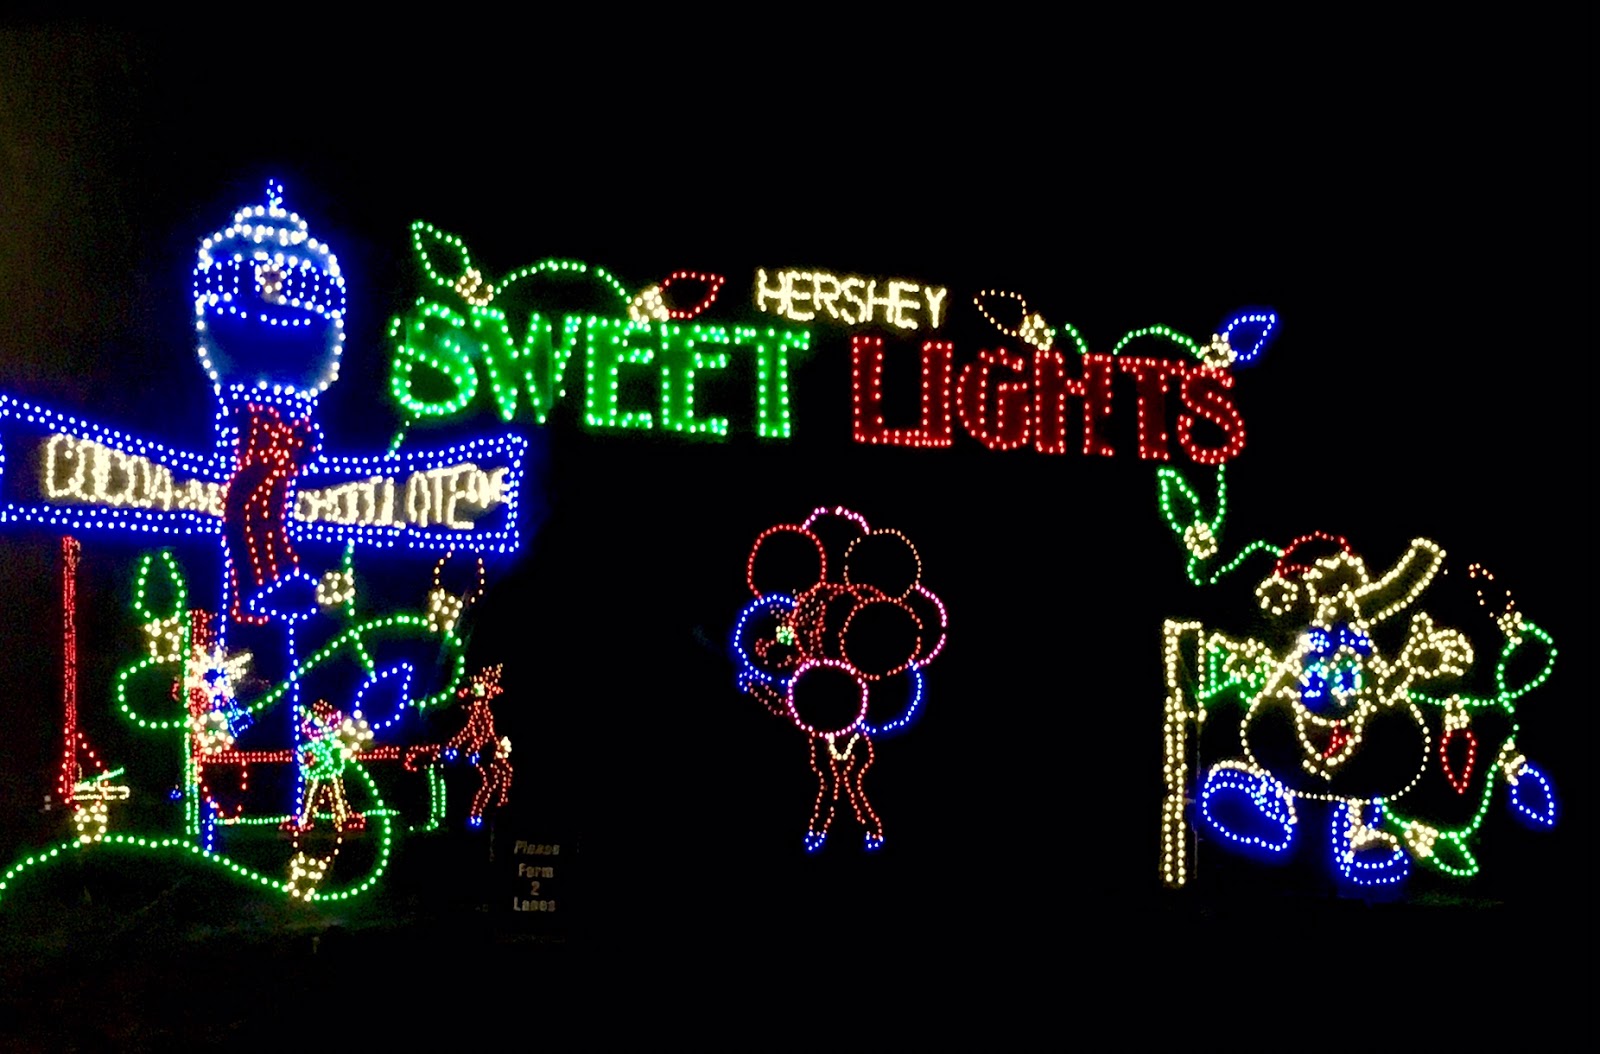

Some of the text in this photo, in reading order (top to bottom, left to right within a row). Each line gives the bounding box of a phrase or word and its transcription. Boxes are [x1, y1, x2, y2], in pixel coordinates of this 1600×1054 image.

[755, 268, 948, 330] HERSHEY
[391, 301, 1246, 464] SWEET LIGHTS
[45, 432, 173, 512] COCOA
[513, 840, 560, 855] Please
[518, 862, 554, 878] Form
[530, 880, 540, 896] 2
[513, 896, 556, 912] Lanes
